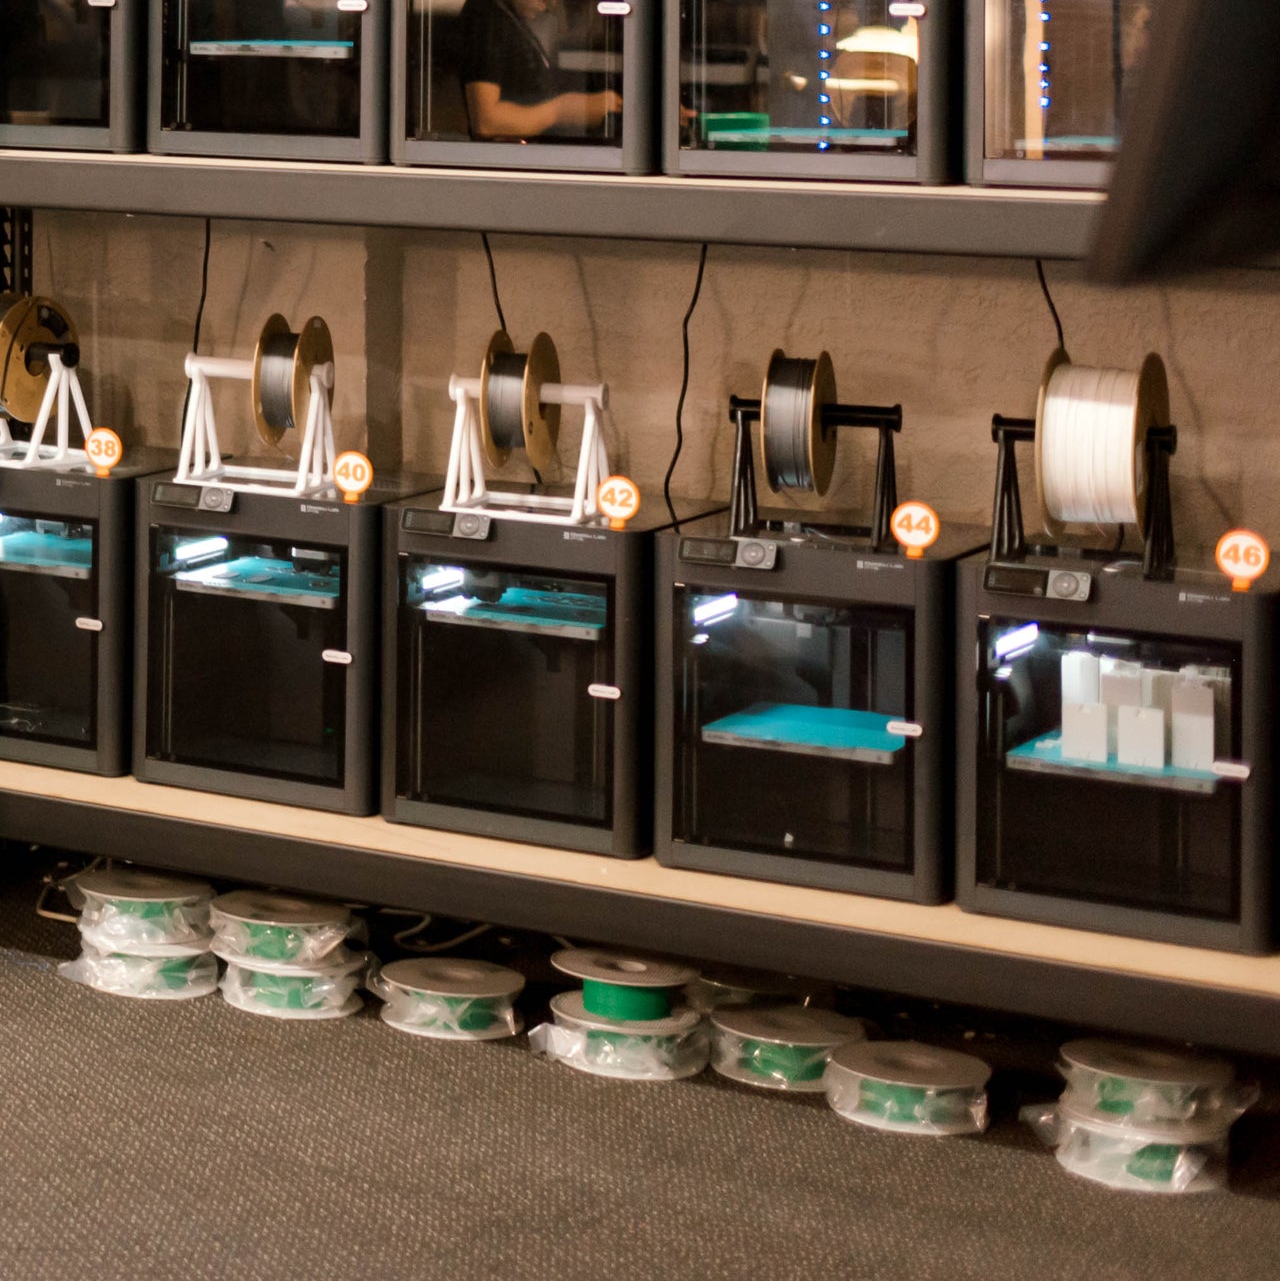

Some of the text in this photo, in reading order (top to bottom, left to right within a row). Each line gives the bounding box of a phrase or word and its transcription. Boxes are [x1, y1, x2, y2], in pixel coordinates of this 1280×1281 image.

[90, 438, 117, 458] 38
[337, 462, 366, 482] 40
[601, 487, 633, 507] 42
[897, 513, 932, 535] 44
[1221, 543, 1261, 567] 46
